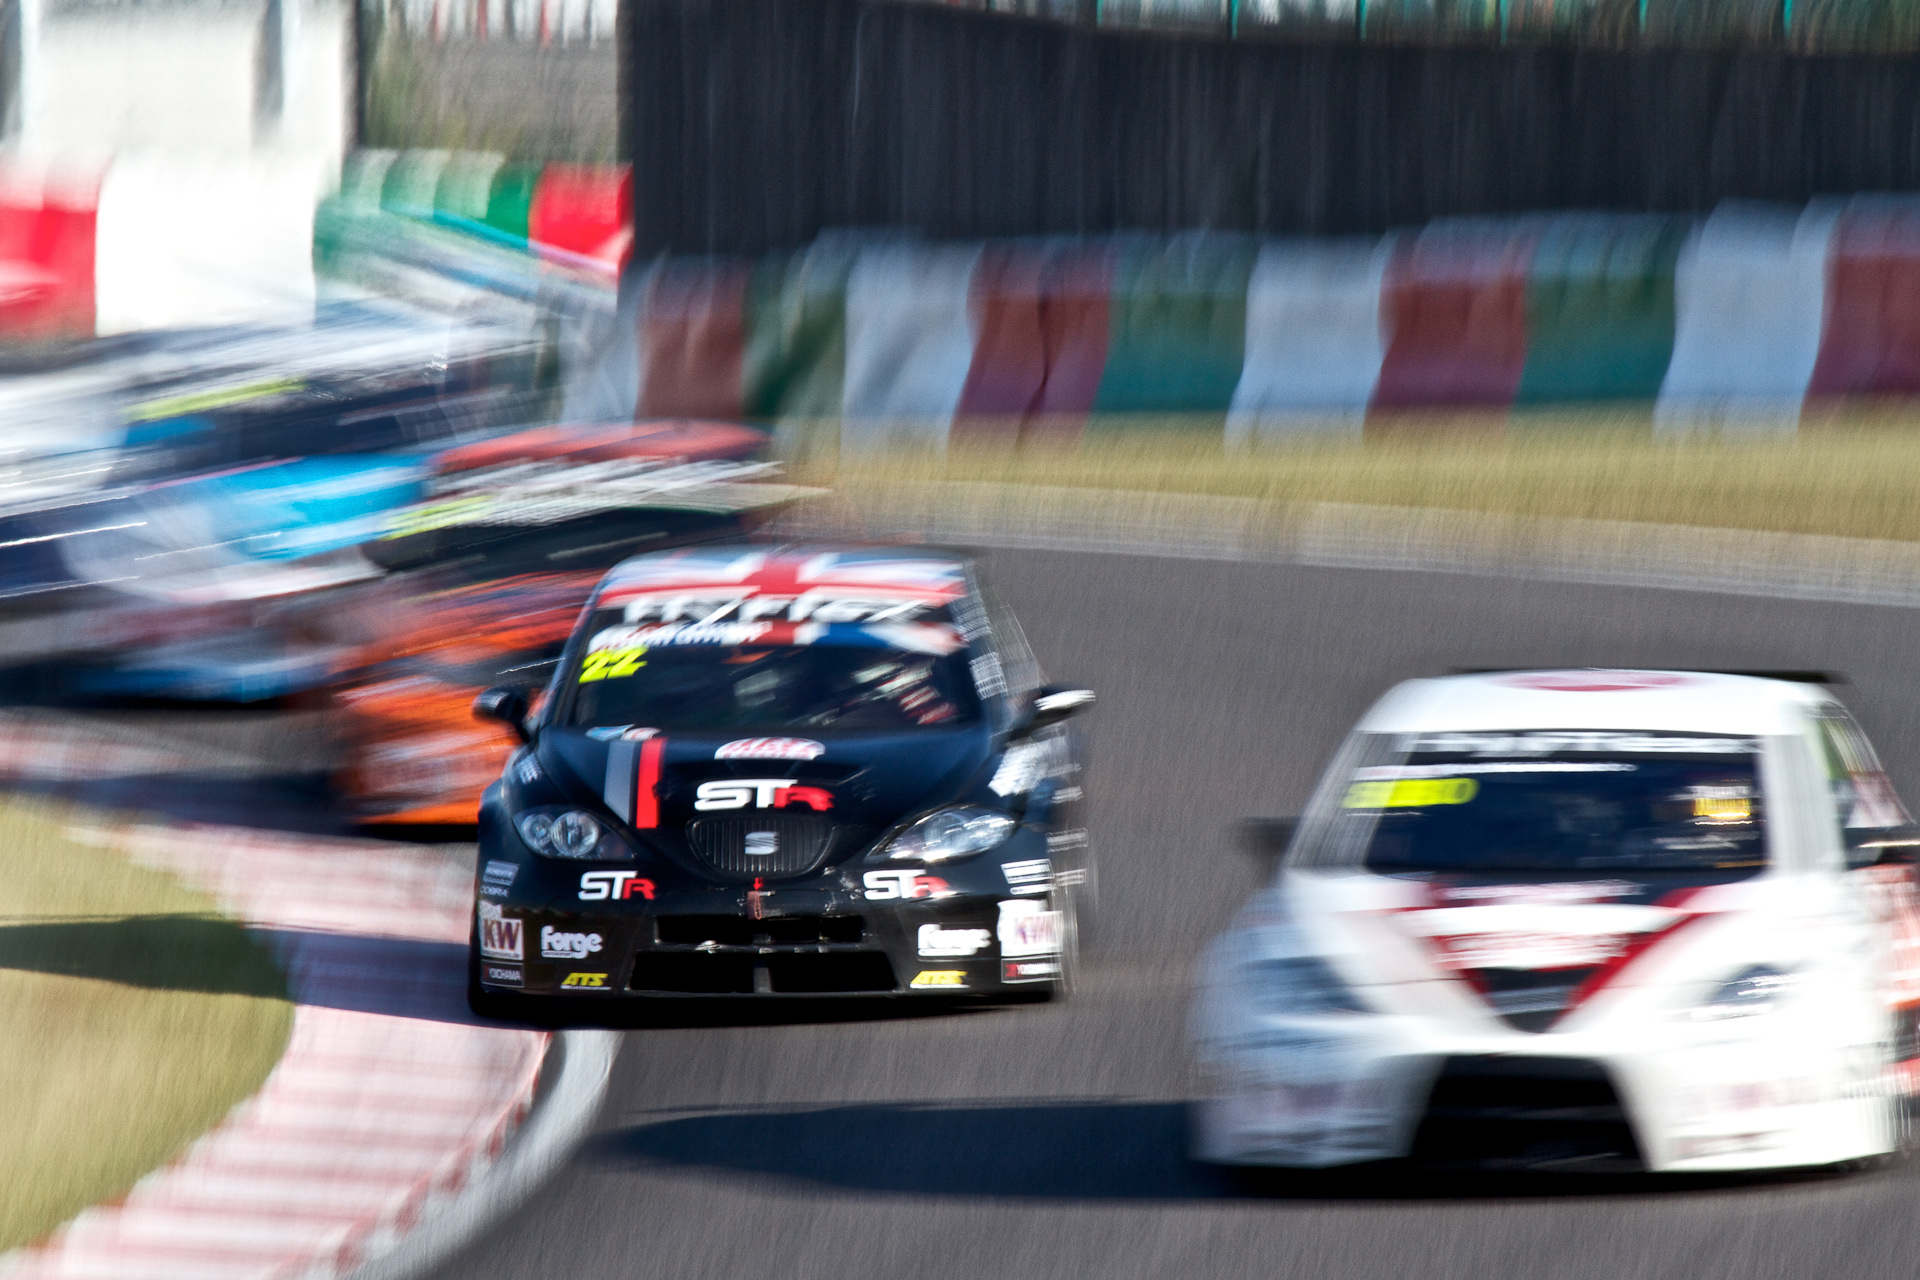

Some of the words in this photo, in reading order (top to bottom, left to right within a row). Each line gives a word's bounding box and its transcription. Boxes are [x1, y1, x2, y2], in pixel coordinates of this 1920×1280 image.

[579, 643, 648, 684] 22
[694, 778, 835, 812] STR
[578, 870, 656, 900] STR
[863, 869, 957, 900] STR
[483, 919, 520, 951] KW
[561, 972, 609, 987] ATS
